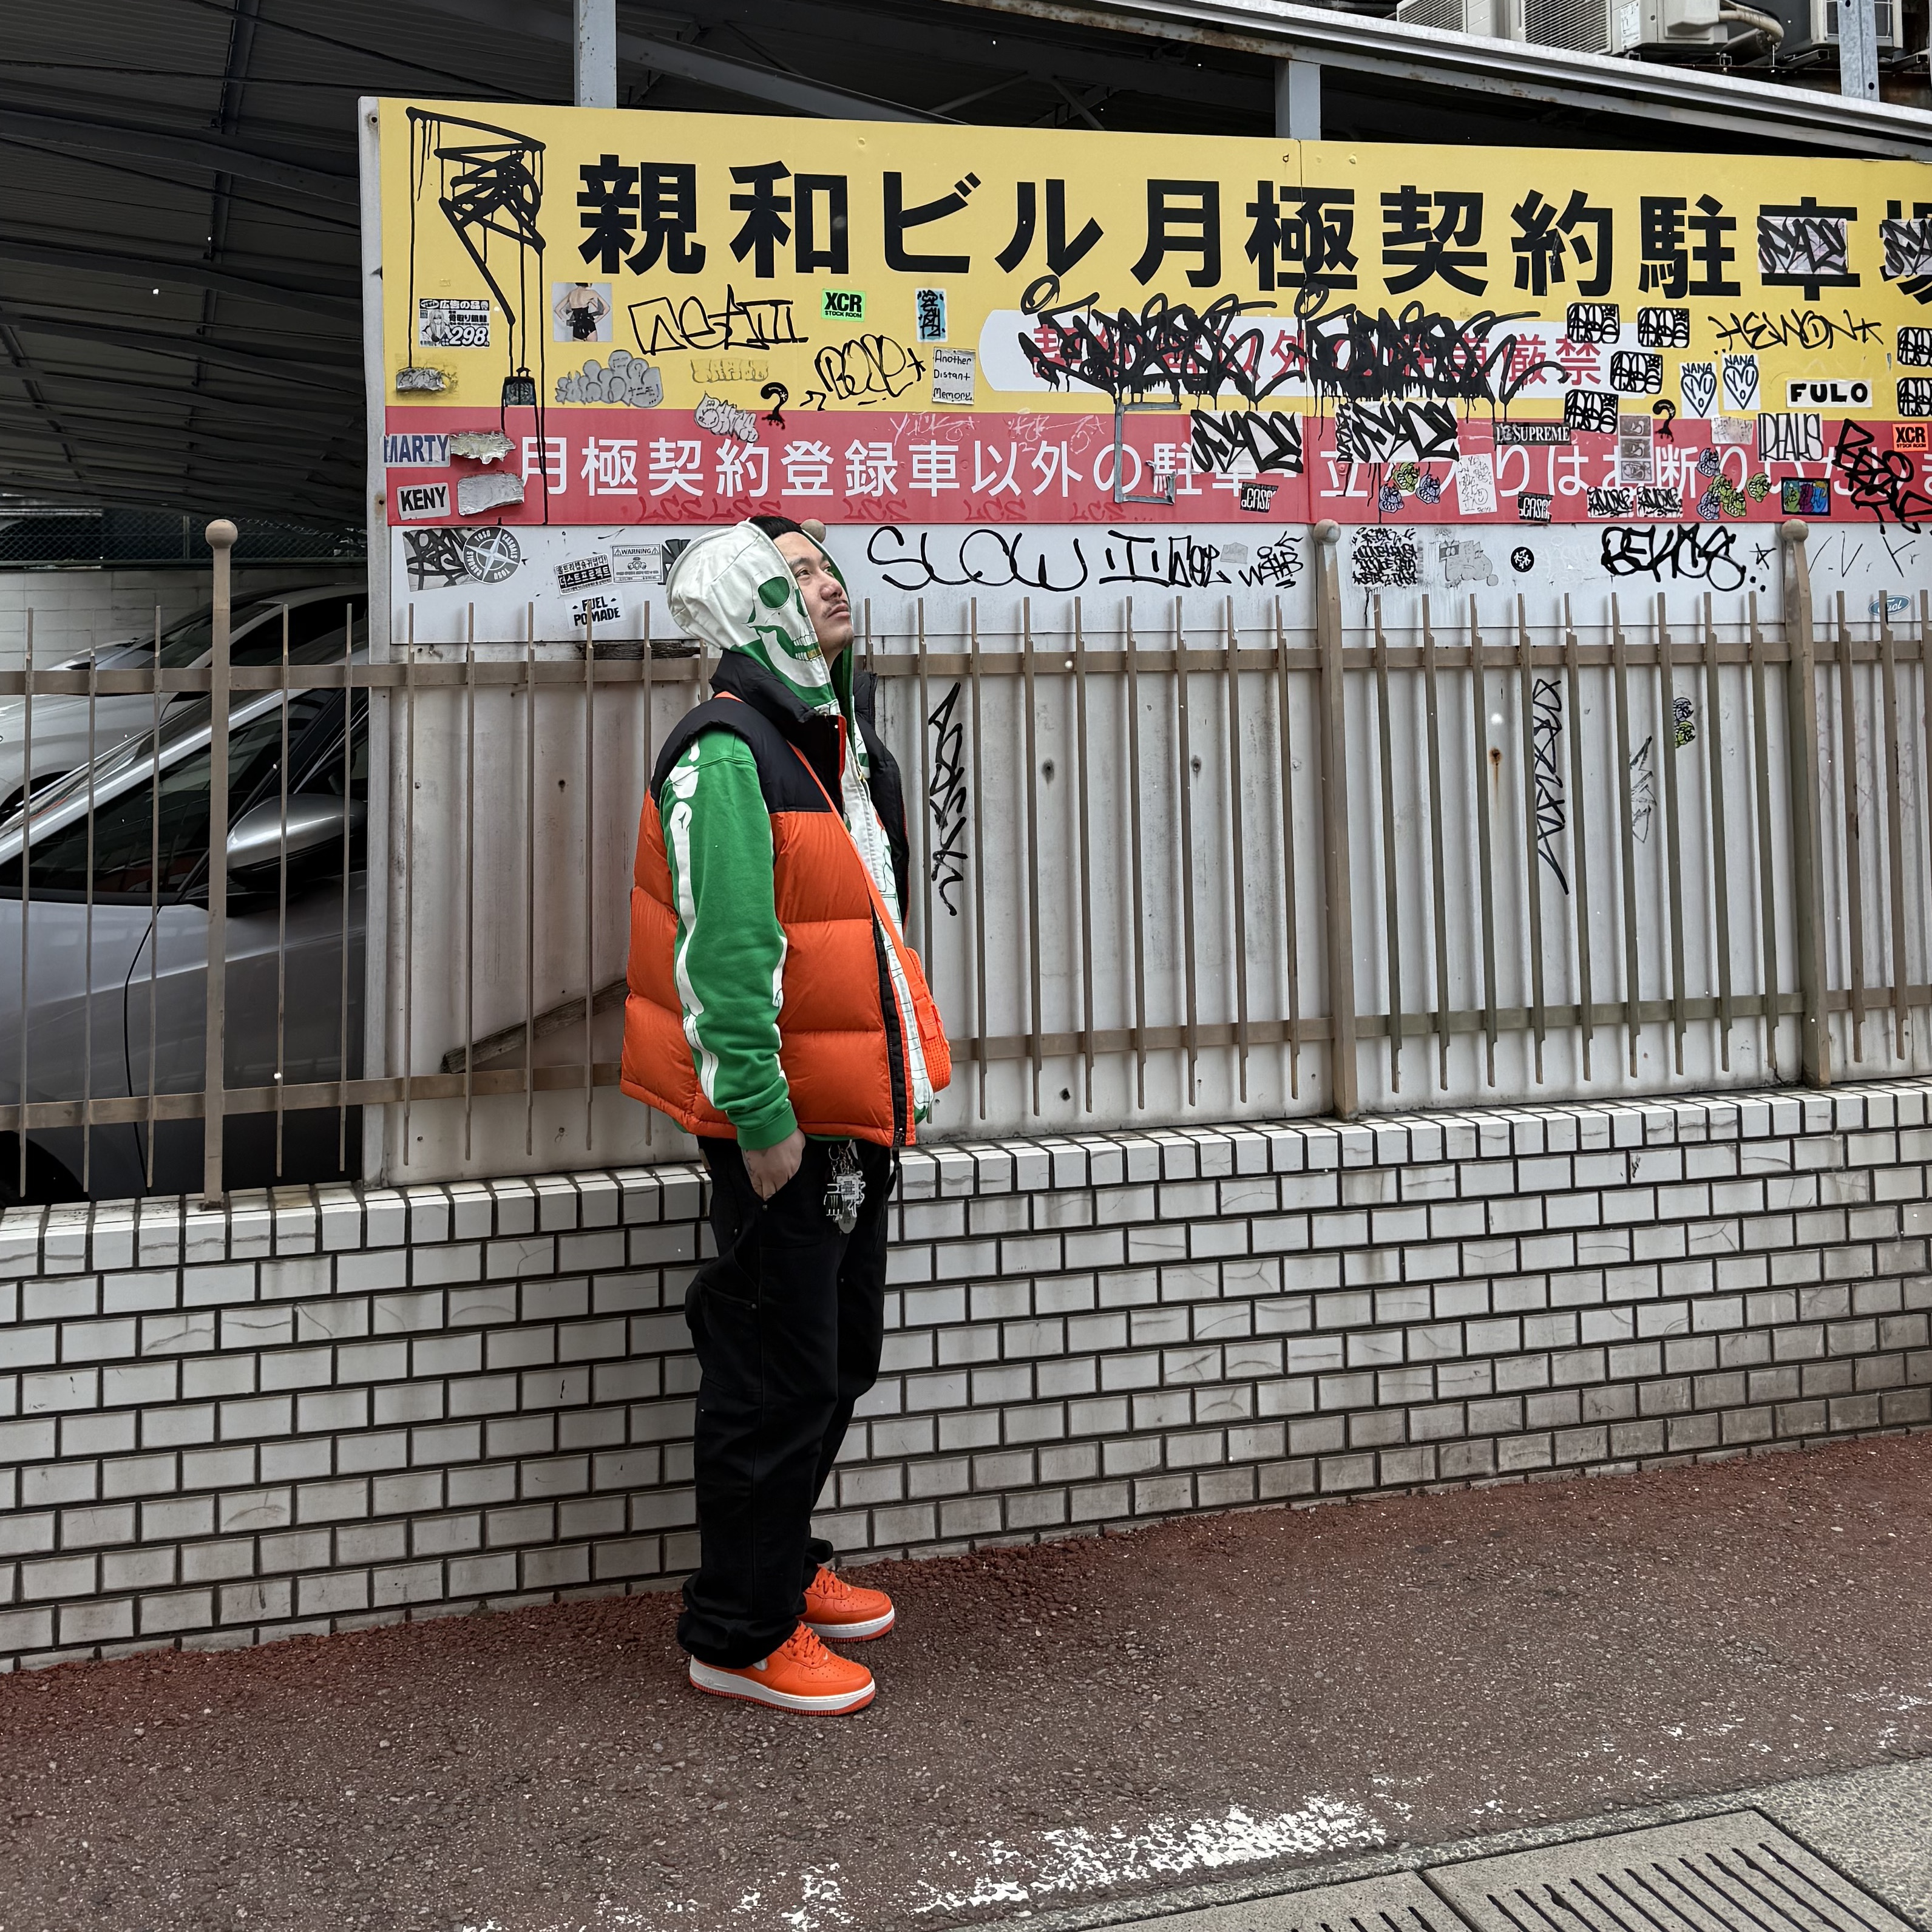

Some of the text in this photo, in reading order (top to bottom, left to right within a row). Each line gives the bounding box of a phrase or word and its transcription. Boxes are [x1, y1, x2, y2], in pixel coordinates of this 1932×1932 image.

[824, 291, 863, 313] XCR
[449, 326, 488, 347] 298
[935, 350, 972, 365] Another
[1724, 354, 1754, 365] NANA
[934, 369, 971, 379] Distant
[1682, 362, 1712, 374] NANA
[1791, 384, 1868, 403] FULO
[1517, 426, 1570, 441] SUPREME
[1895, 427, 1926, 442] XCR
[384, 435, 449, 463] MARTY
[401, 486, 446, 511] KENY
[582, 596, 608, 611] FUEL
[574, 607, 621, 626] POMADE
